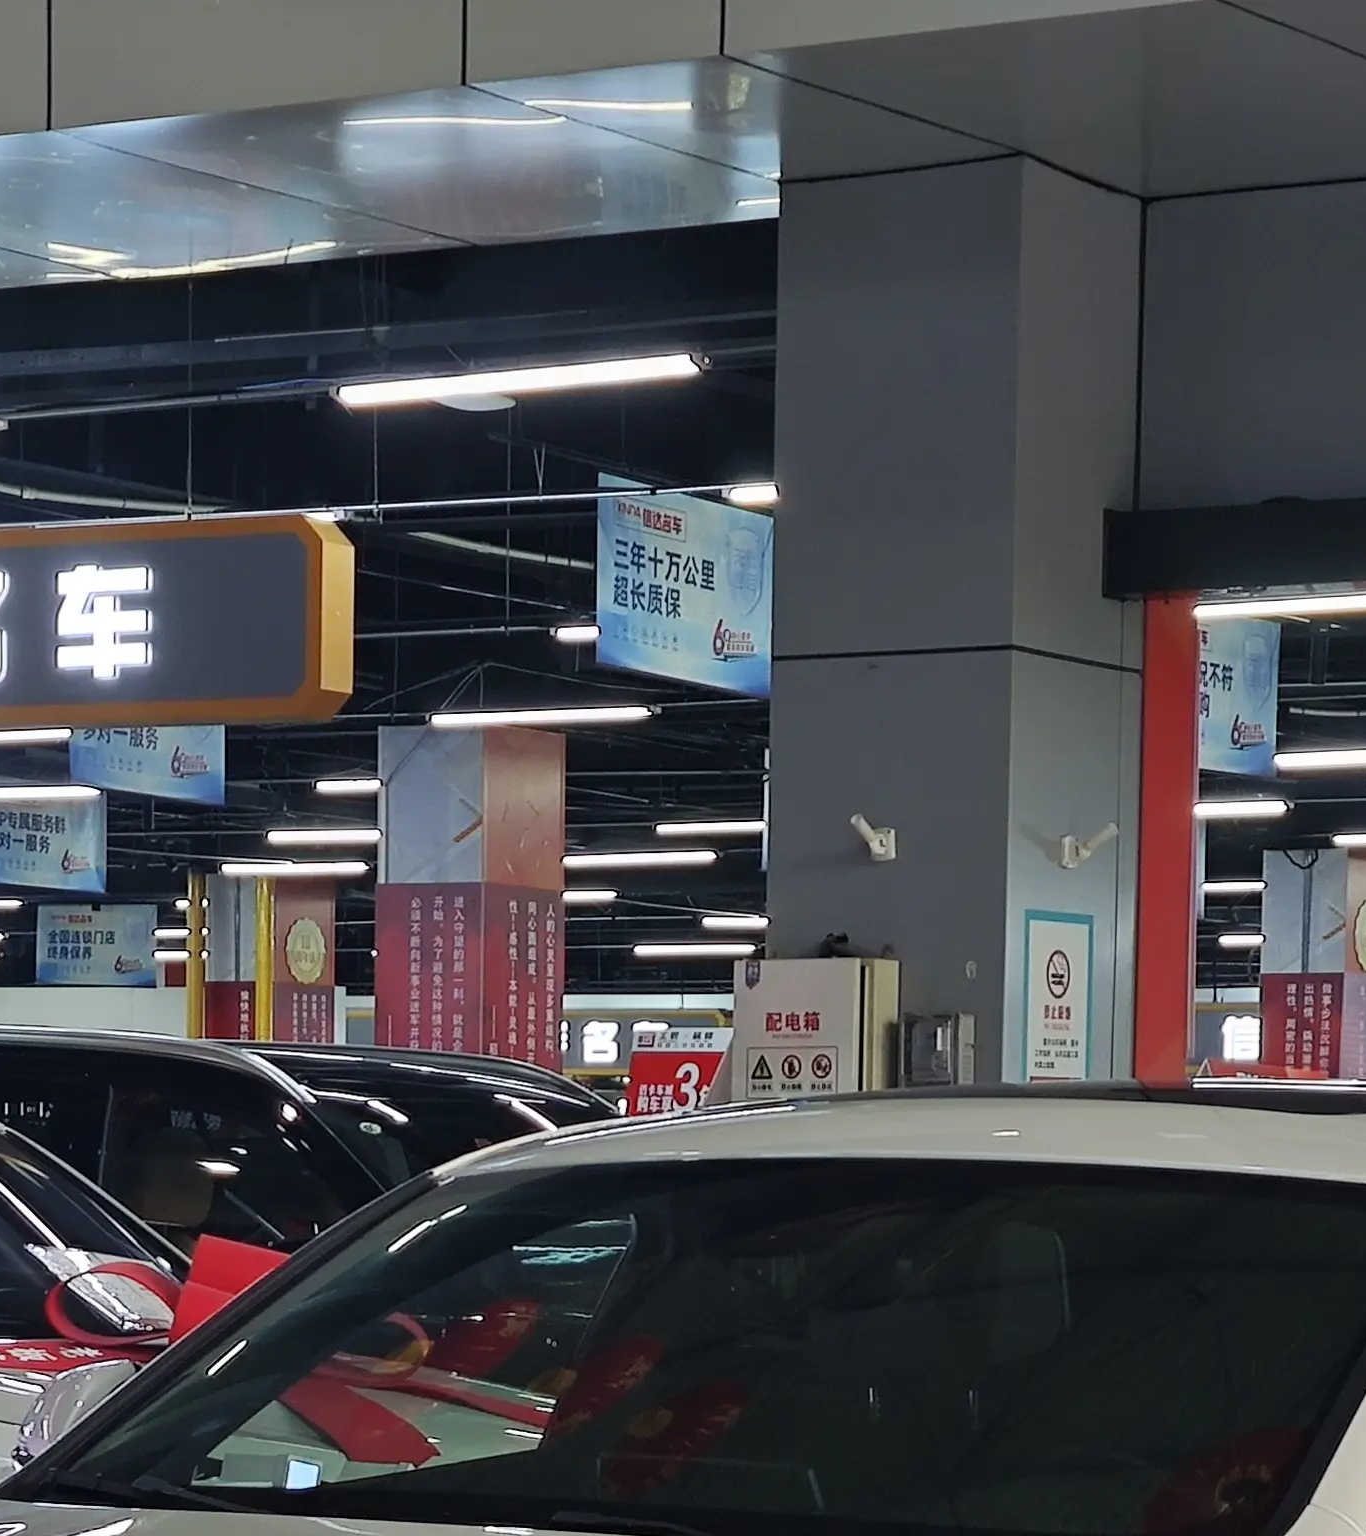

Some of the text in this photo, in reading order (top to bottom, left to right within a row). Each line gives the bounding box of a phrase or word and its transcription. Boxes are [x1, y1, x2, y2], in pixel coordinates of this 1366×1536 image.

[642, 508, 683, 536] 信达名车
[614, 538, 715, 591] 三年十万公里
[613, 575, 682, 619] 超长质保
[765, 1011, 821, 1032] 配电箱
